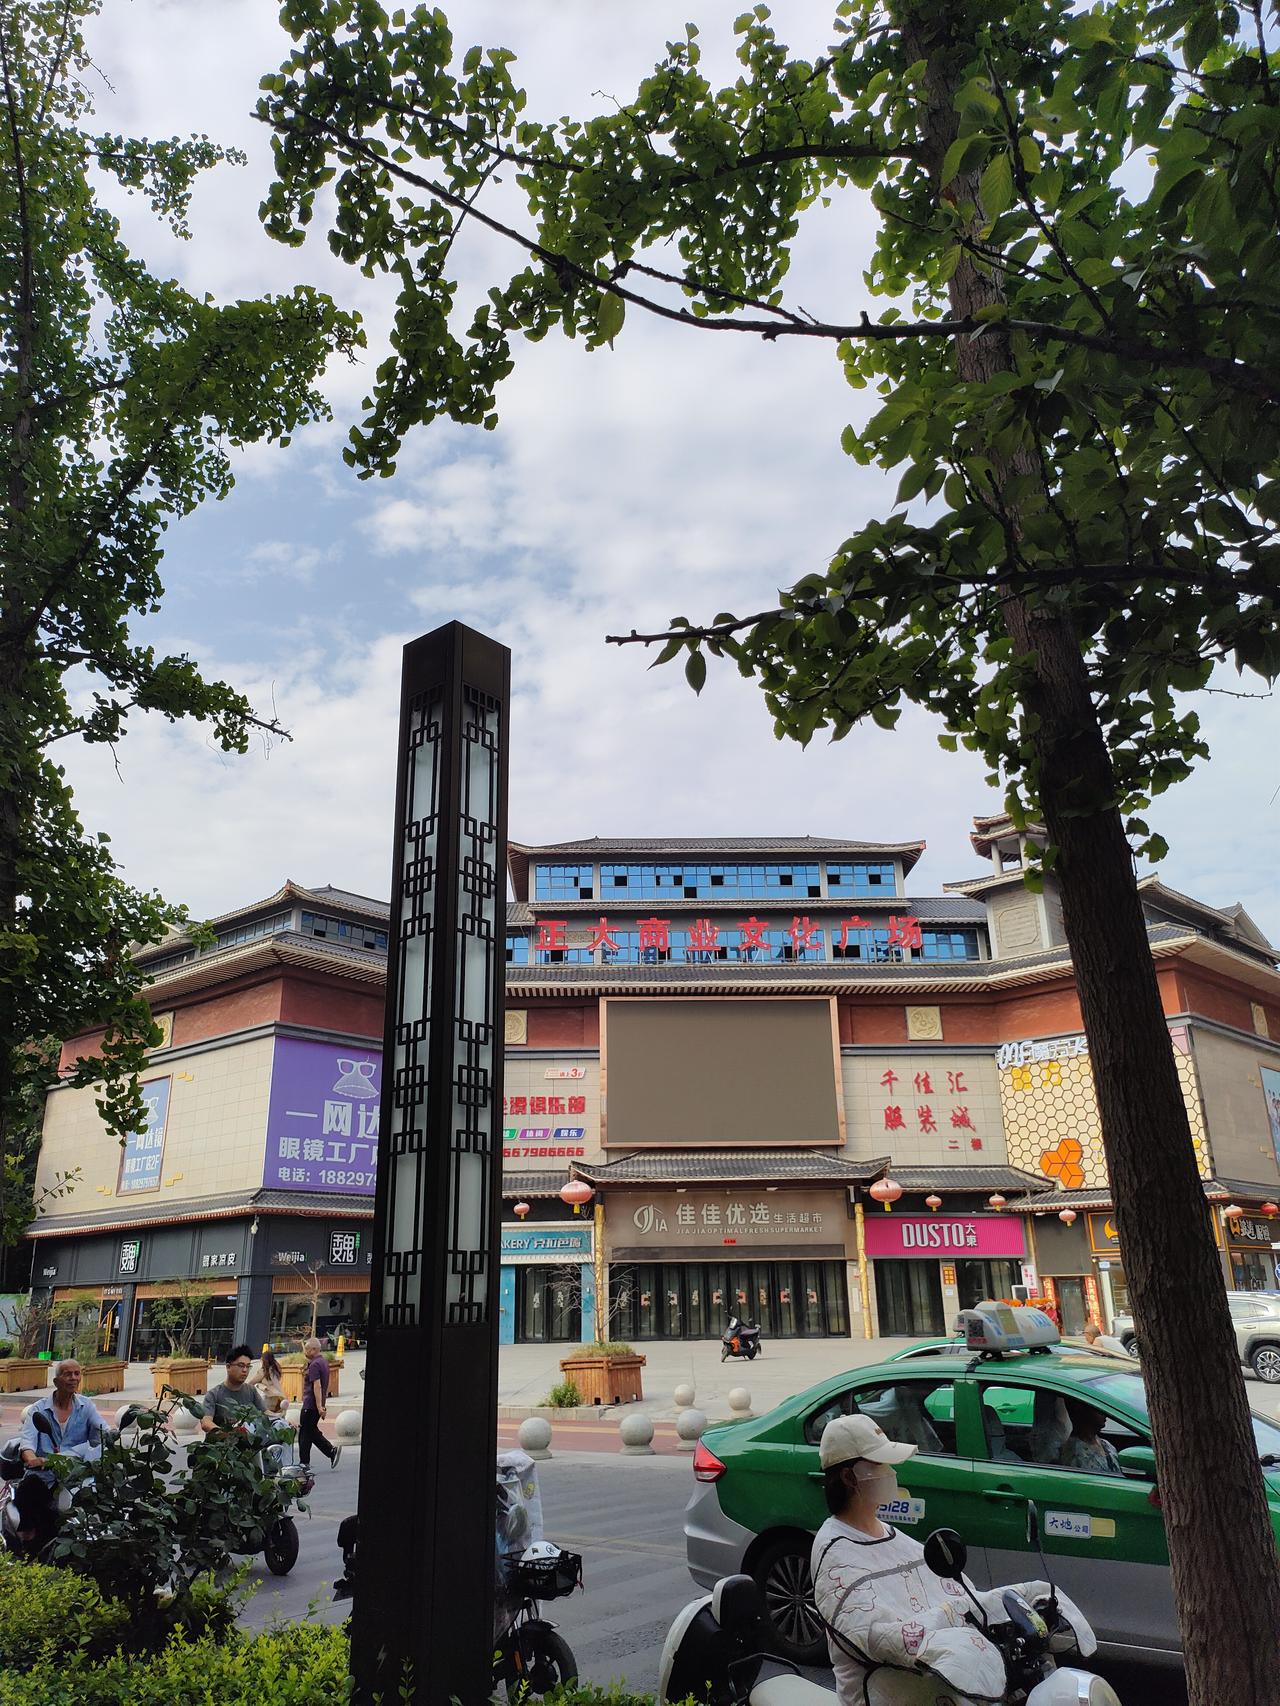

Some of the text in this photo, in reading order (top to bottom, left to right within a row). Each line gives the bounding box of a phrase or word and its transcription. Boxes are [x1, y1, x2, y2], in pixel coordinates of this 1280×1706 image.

[535, 915, 922, 952] 正大商业文化广场
[884, 1104, 976, 1135] 服装城
[560, 1129, 578, 1138] 娱乐
[279, 1136, 378, 1165] 眼镜工厂
[675, 1203, 822, 1225] 佳佳优选 生活超市
[902, 1223, 965, 1247] DUSTO
[278, 1251, 305, 1264] Weijia
